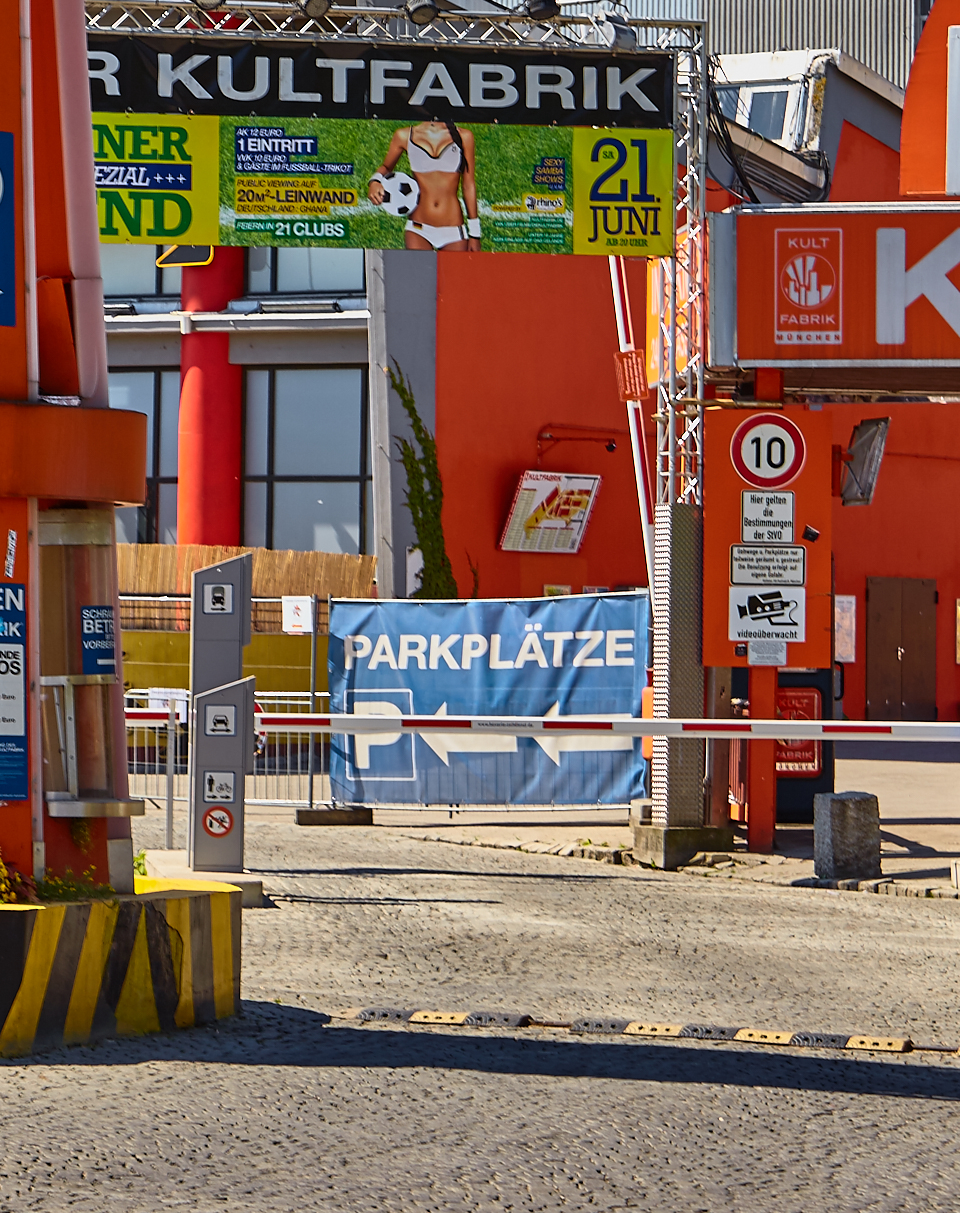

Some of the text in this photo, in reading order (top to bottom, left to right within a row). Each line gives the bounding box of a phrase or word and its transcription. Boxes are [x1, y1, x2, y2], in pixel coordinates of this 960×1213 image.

[157, 52, 658, 113] KULTFABRIK
[260, 129, 283, 137] EURO
[238, 138, 315, 153] 1 EINTRITT
[263, 155, 286, 163] EURO
[602, 151, 615, 159] SA
[544, 158, 564, 166] SEXY
[536, 167, 564, 175] SAMBA
[590, 137, 661, 203] 21.
[237, 179, 266, 187] PUBLIC
[301, 180, 317, 188] AUF
[534, 175, 564, 183] SHOWS
[96, 191, 192, 237] ND
[300, 205, 327, 214] GHANA
[588, 206, 661, 243] JUNI
[275, 223, 291, 236] 21
[293, 223, 345, 237] CLUBS
[606, 238, 618, 246] AB
[629, 239, 648, 247] UHR
[788, 238, 829, 248] KULT
[780, 314, 836, 324] FABRIK
[776, 333, 840, 341] MÜNCHEN
[751, 437, 785, 469] 10
[750, 494, 786, 506] Hier gelten
[763, 507, 773, 517] die
[744, 517, 792, 529] Bestimmungen
[753, 530, 782, 540] der StVO
[737, 629, 798, 639] videoüberwacht
[344, 623, 635, 670] PARKPLÄTZE
